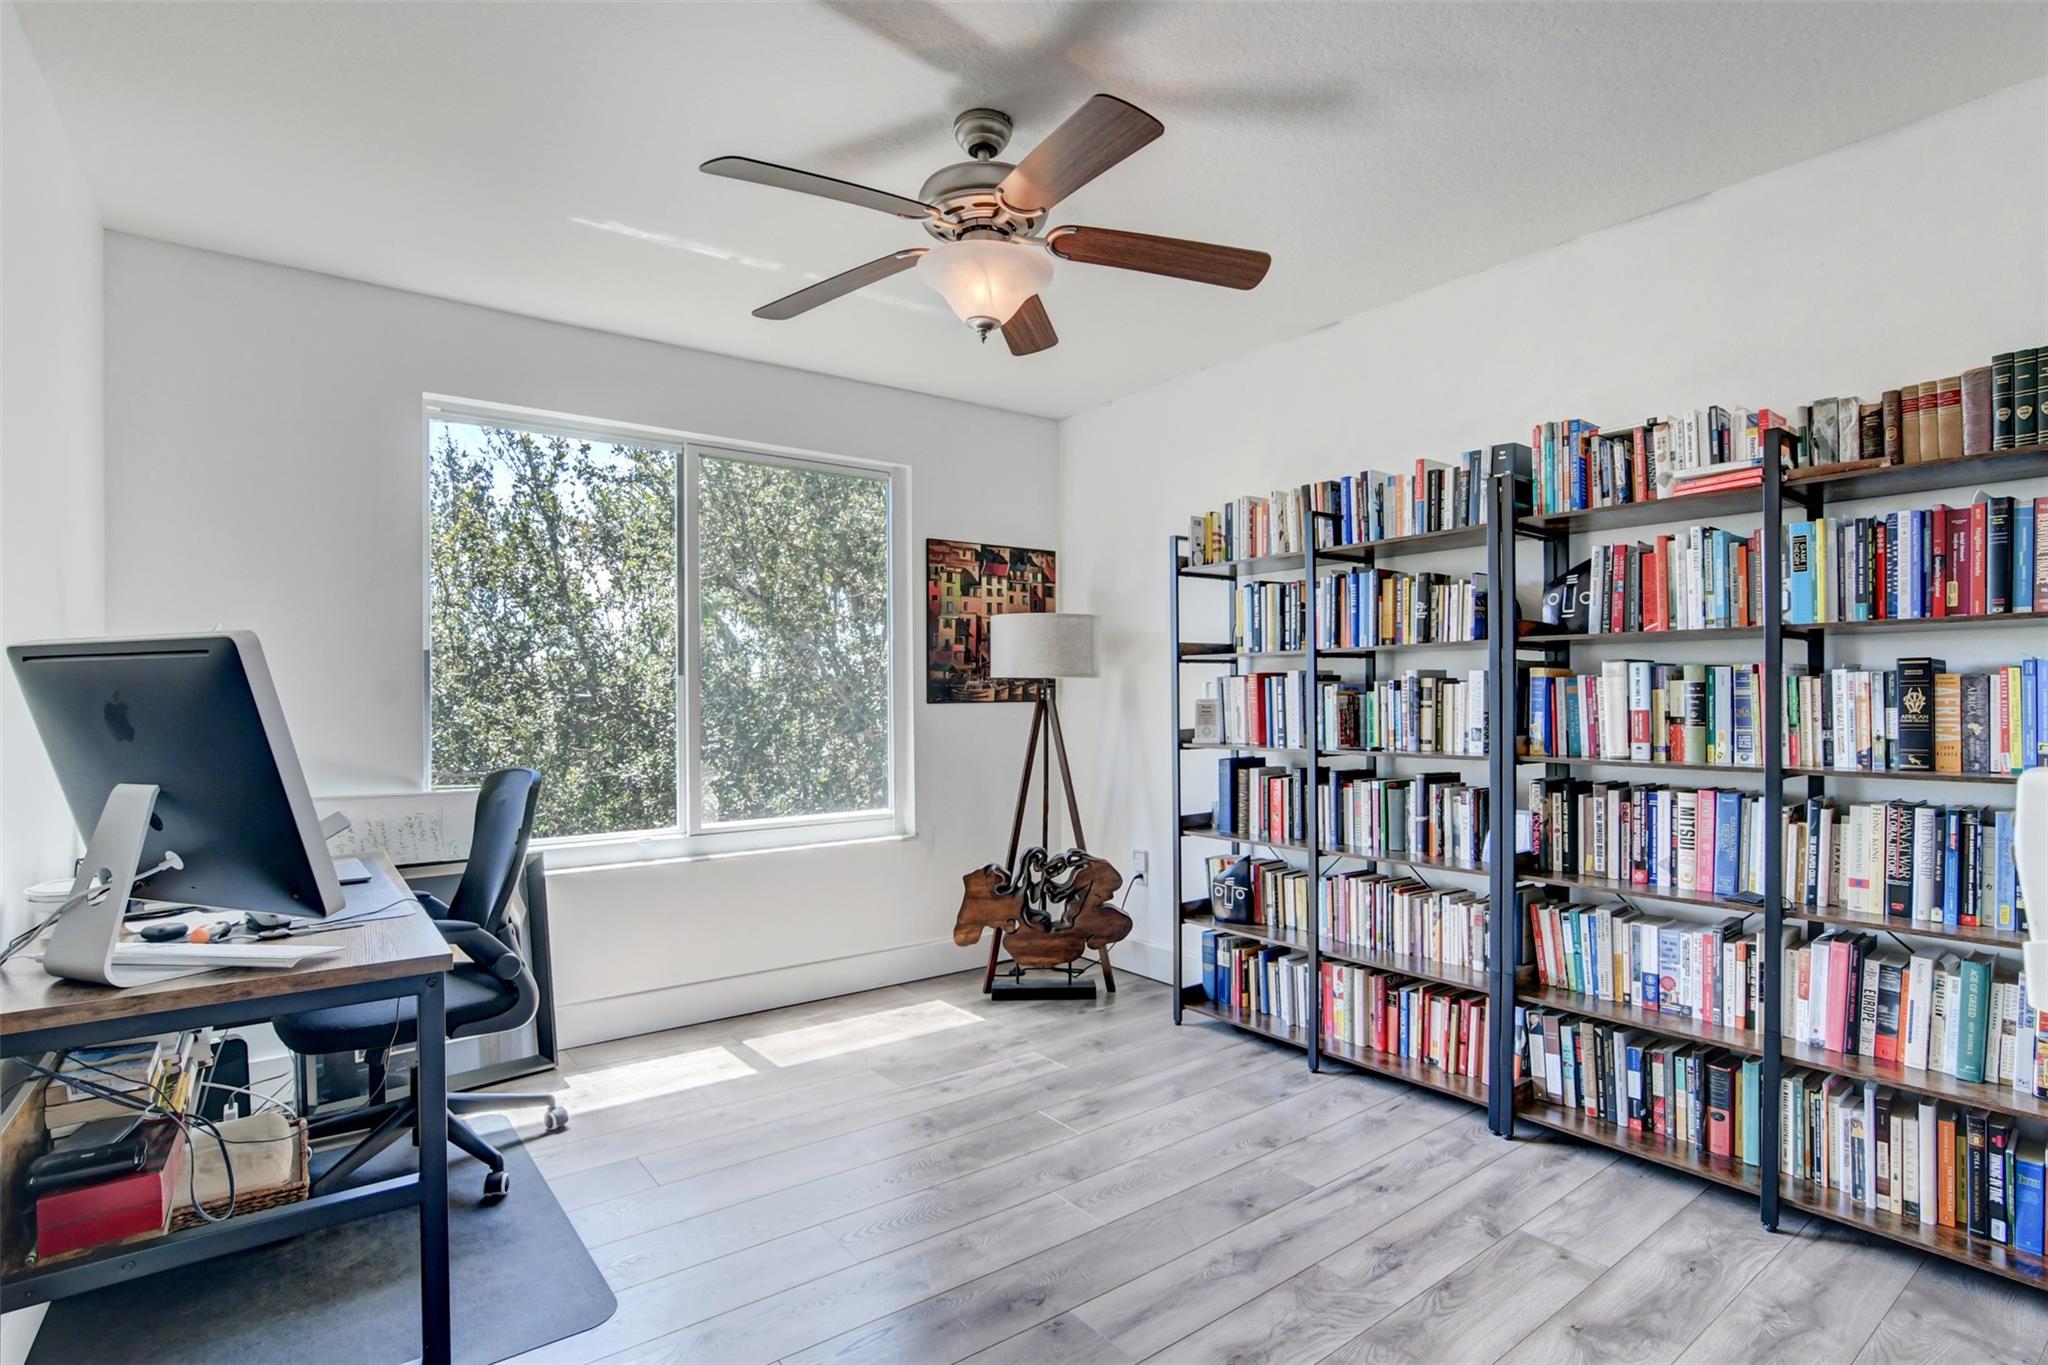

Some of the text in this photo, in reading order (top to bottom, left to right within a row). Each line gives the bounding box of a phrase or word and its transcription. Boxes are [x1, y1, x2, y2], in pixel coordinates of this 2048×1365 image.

[1647, 452, 1656, 491] JAPANESE
[1793, 543, 1801, 566] THEORY
[1974, 527, 1982, 552] Neighbor
[2036, 513, 2048, 585] BEHAVIORAL FINANCE
[1935, 687, 1960, 741] AFRICA
[1967, 685, 1977, 715] AFRICA
[1680, 806, 1695, 851] MITSUI
[1871, 807, 1882, 863] HONG KONG
[1888, 808, 1898, 877] AN ORAL HISTORY
[1898, 809, 1912, 878] JAPAN AT WAR
[1920, 814, 1933, 879] PARTNERSHIP
[1833, 843, 1841, 874] JAPAN
[1862, 989, 1877, 1024] EUROPE
[1935, 979, 1944, 1017] COLOR LAW
[1967, 968, 1978, 1018] AGE OF GREED
[1586, 1033, 1594, 1060] JUNG
[1989, 1152, 2003, 1179] THINKING
[1989, 1185, 2003, 1205] TIME
